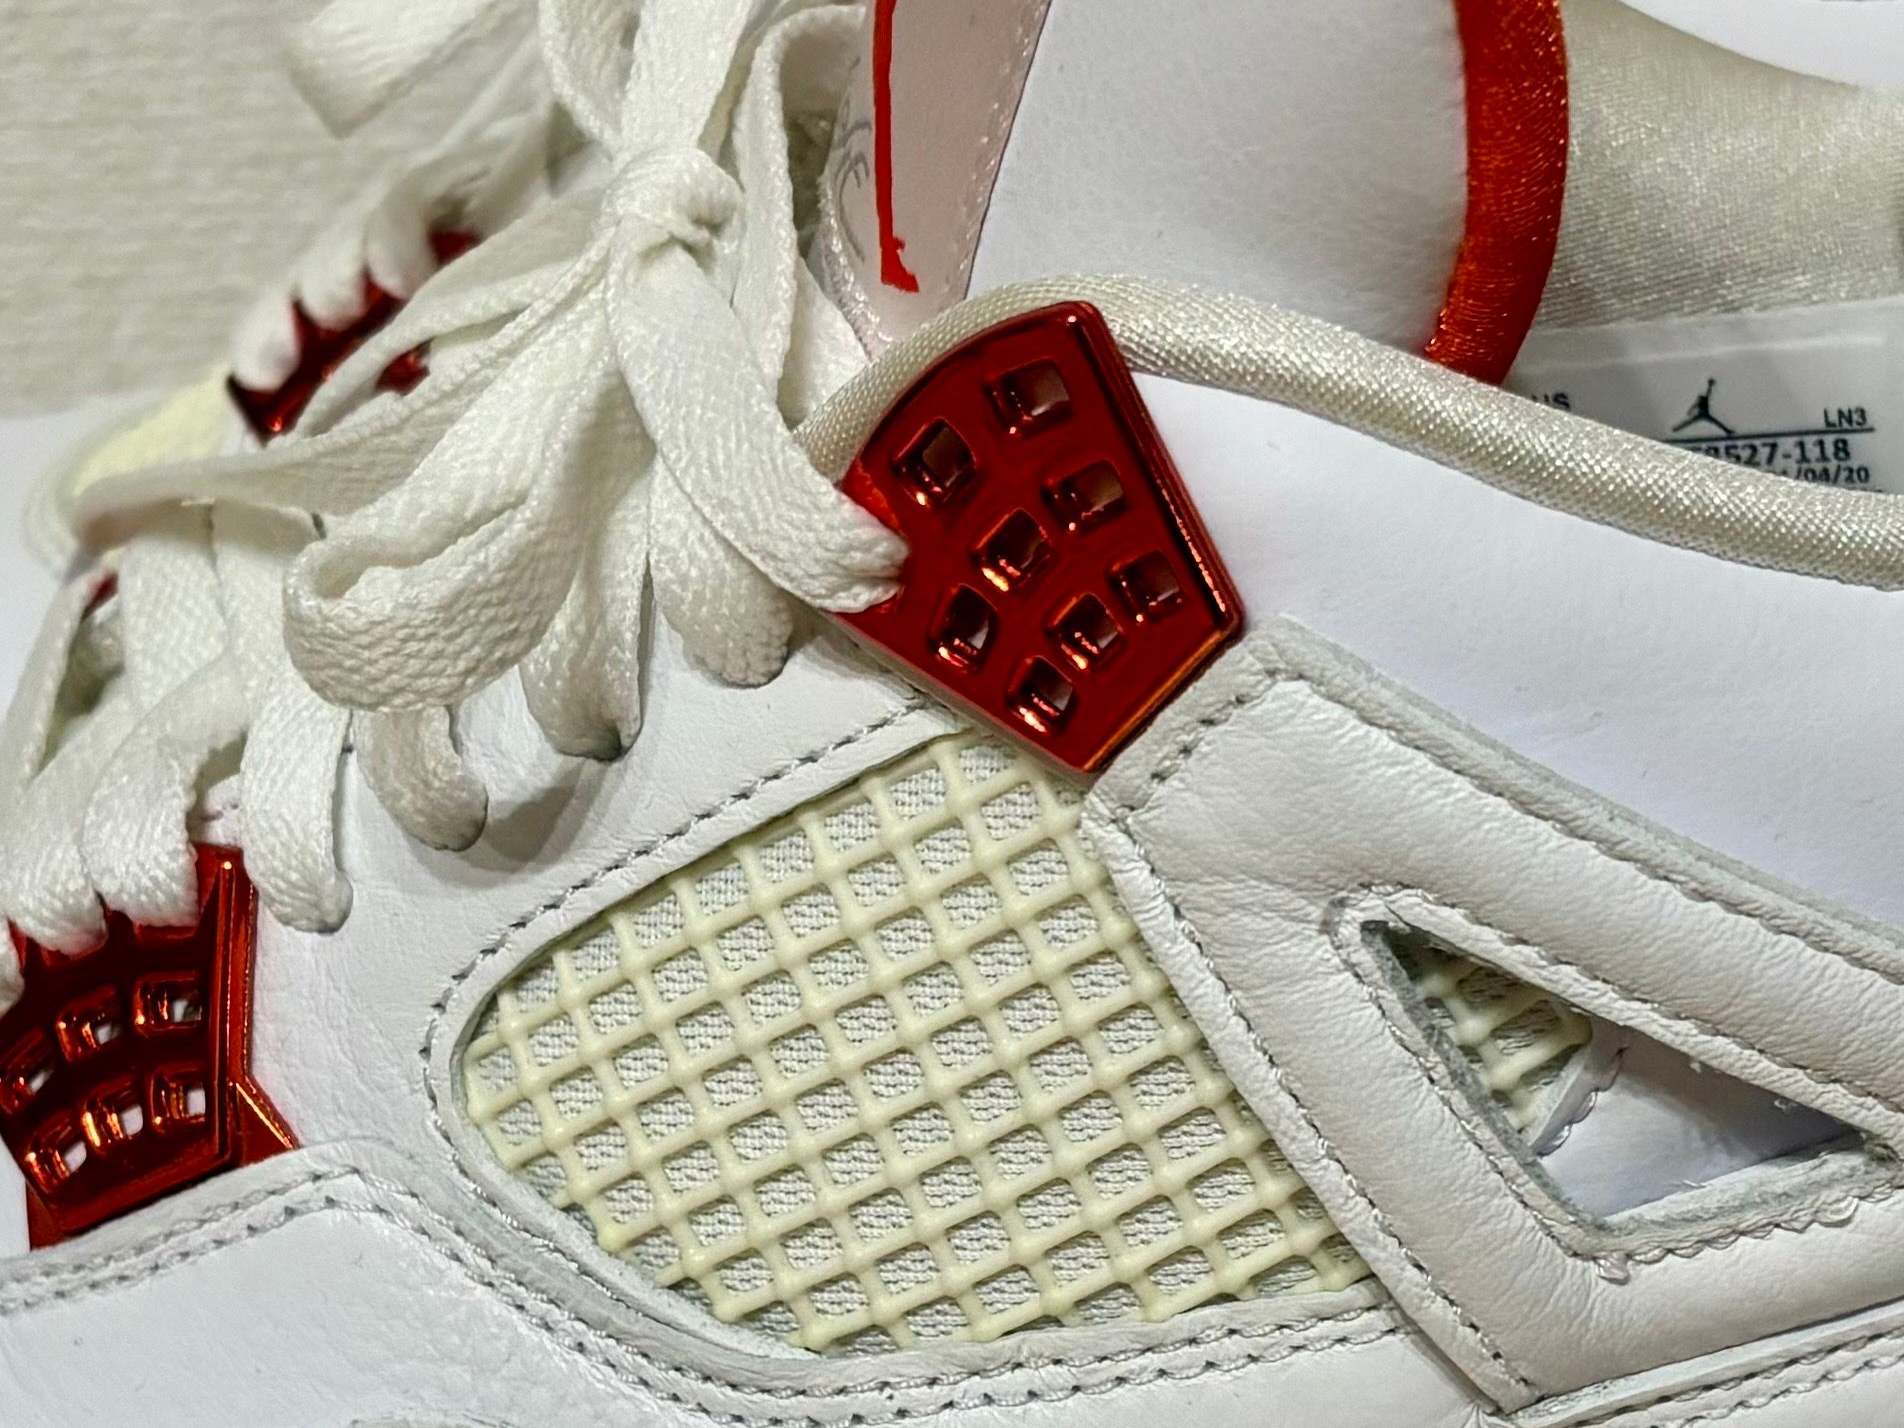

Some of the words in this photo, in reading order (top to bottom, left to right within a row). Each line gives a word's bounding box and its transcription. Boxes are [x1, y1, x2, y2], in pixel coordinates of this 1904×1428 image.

[1823, 407, 1867, 428] LN3
[1684, 438, 1851, 464] 527-118
[1765, 464, 1870, 484] /04/20
